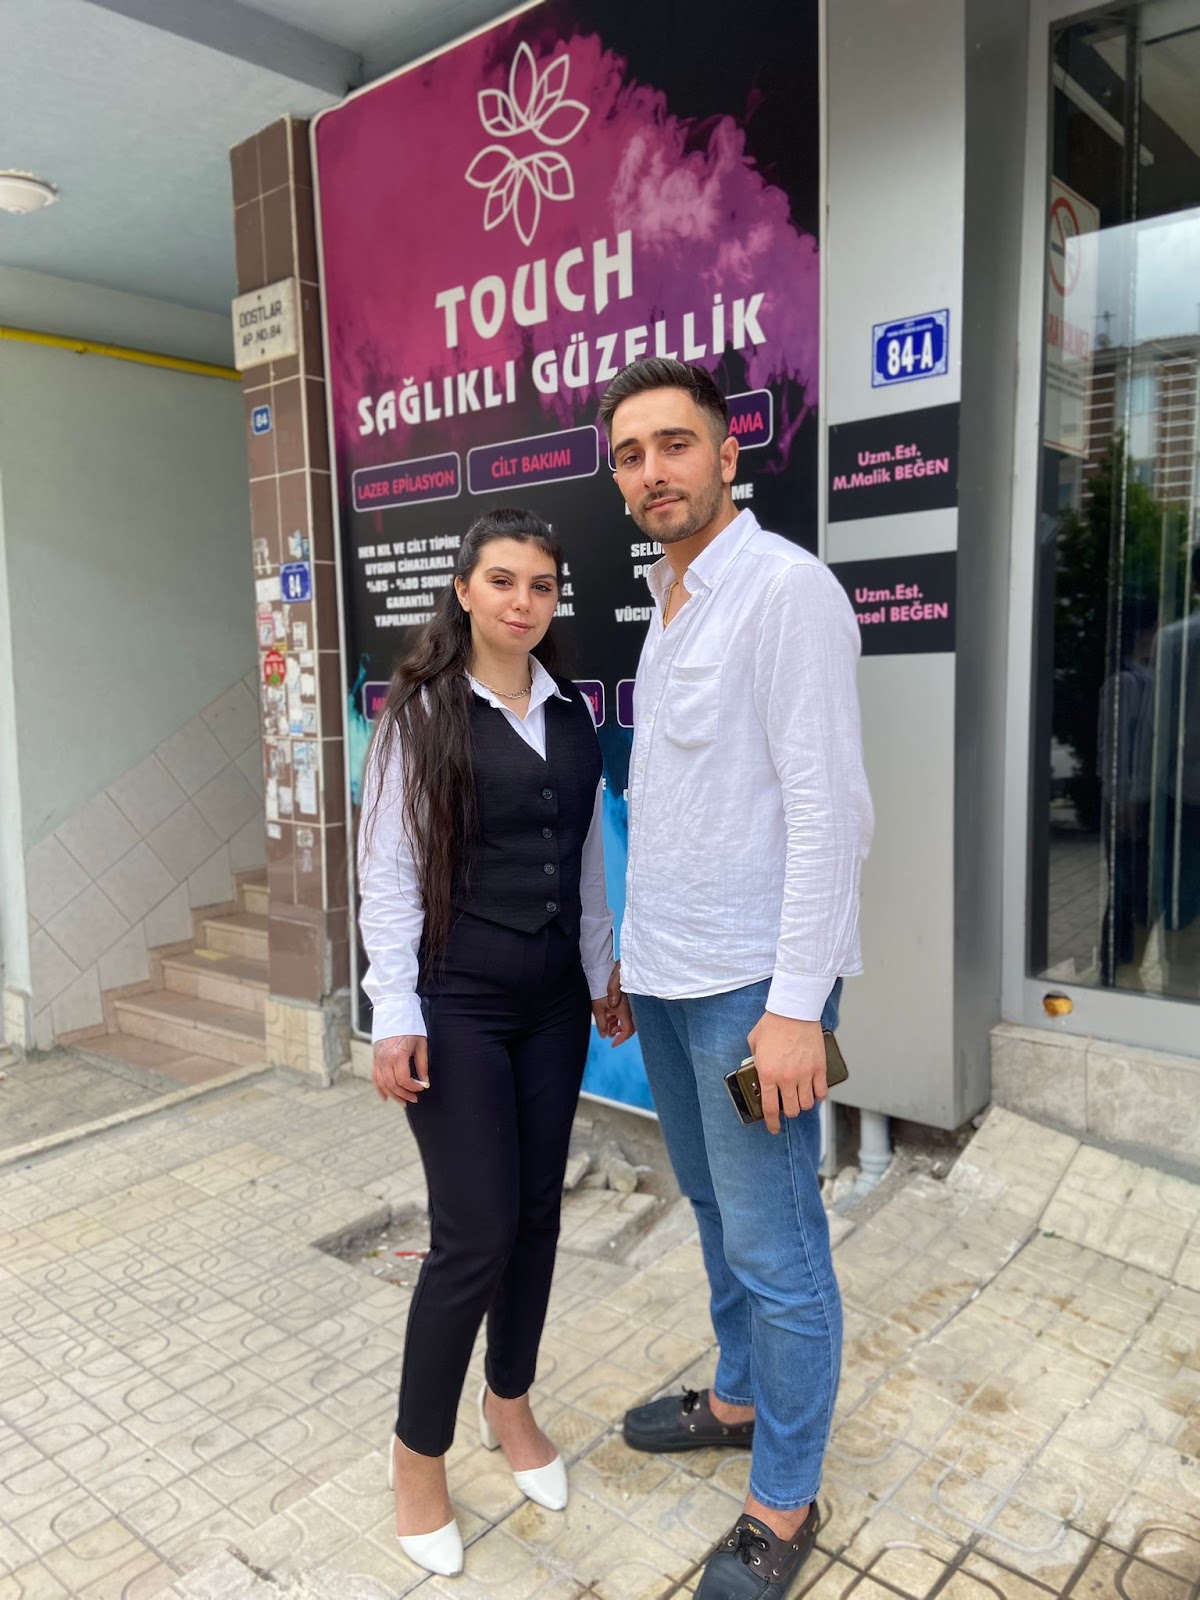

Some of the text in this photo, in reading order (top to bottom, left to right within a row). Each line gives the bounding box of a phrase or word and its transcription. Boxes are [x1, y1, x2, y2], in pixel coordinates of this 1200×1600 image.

[435, 230, 633, 349] TOUCH
[239, 300, 283, 328] DOSTLAR
[357, 293, 767, 436] SAĞLIKLI GÜZELLİK
[887, 331, 934, 376] 84-A
[728, 411, 764, 435] AMA
[491, 449, 572, 479] CİLT BAKIMI
[858, 443, 922, 466] Uzm.Est.
[358, 469, 455, 500] LAZER EPİLASYON
[833, 457, 949, 490] M.Malik BEĞEN
[393, 541, 405, 555] VE
[406, 538, 428, 553] CİLT
[855, 584, 923, 604] Uzm.Est.
[855, 600, 949, 624] nsel BEĞEN
